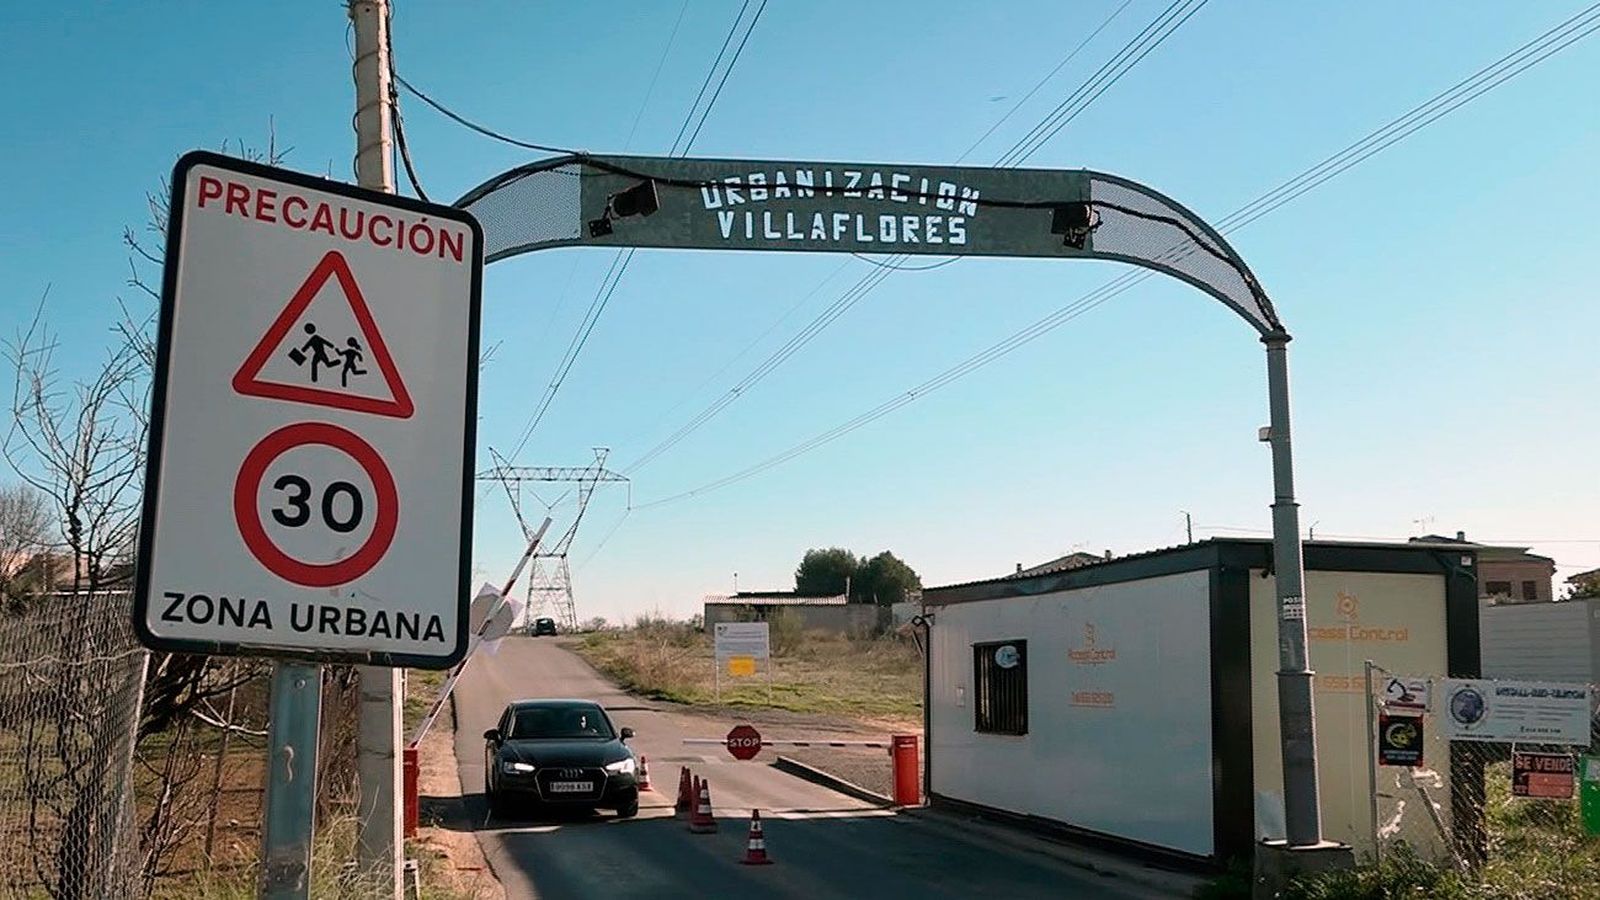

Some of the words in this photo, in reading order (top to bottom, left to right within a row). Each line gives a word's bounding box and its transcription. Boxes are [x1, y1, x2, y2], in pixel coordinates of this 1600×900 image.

[700, 169, 980, 217] URBANIZACION
[197, 175, 465, 263] PRECAUCIÓN
[717, 210, 966, 245] VILLAFLORES
[271, 474, 364, 533] 30
[161, 591, 273, 630] ZONA
[290, 602, 445, 643] URBANA
[1350, 626, 1409, 641] Control
[729, 738, 759, 747] STOP
[1515, 754, 1533, 770] SE
[1535, 757, 1572, 772] VENDE
